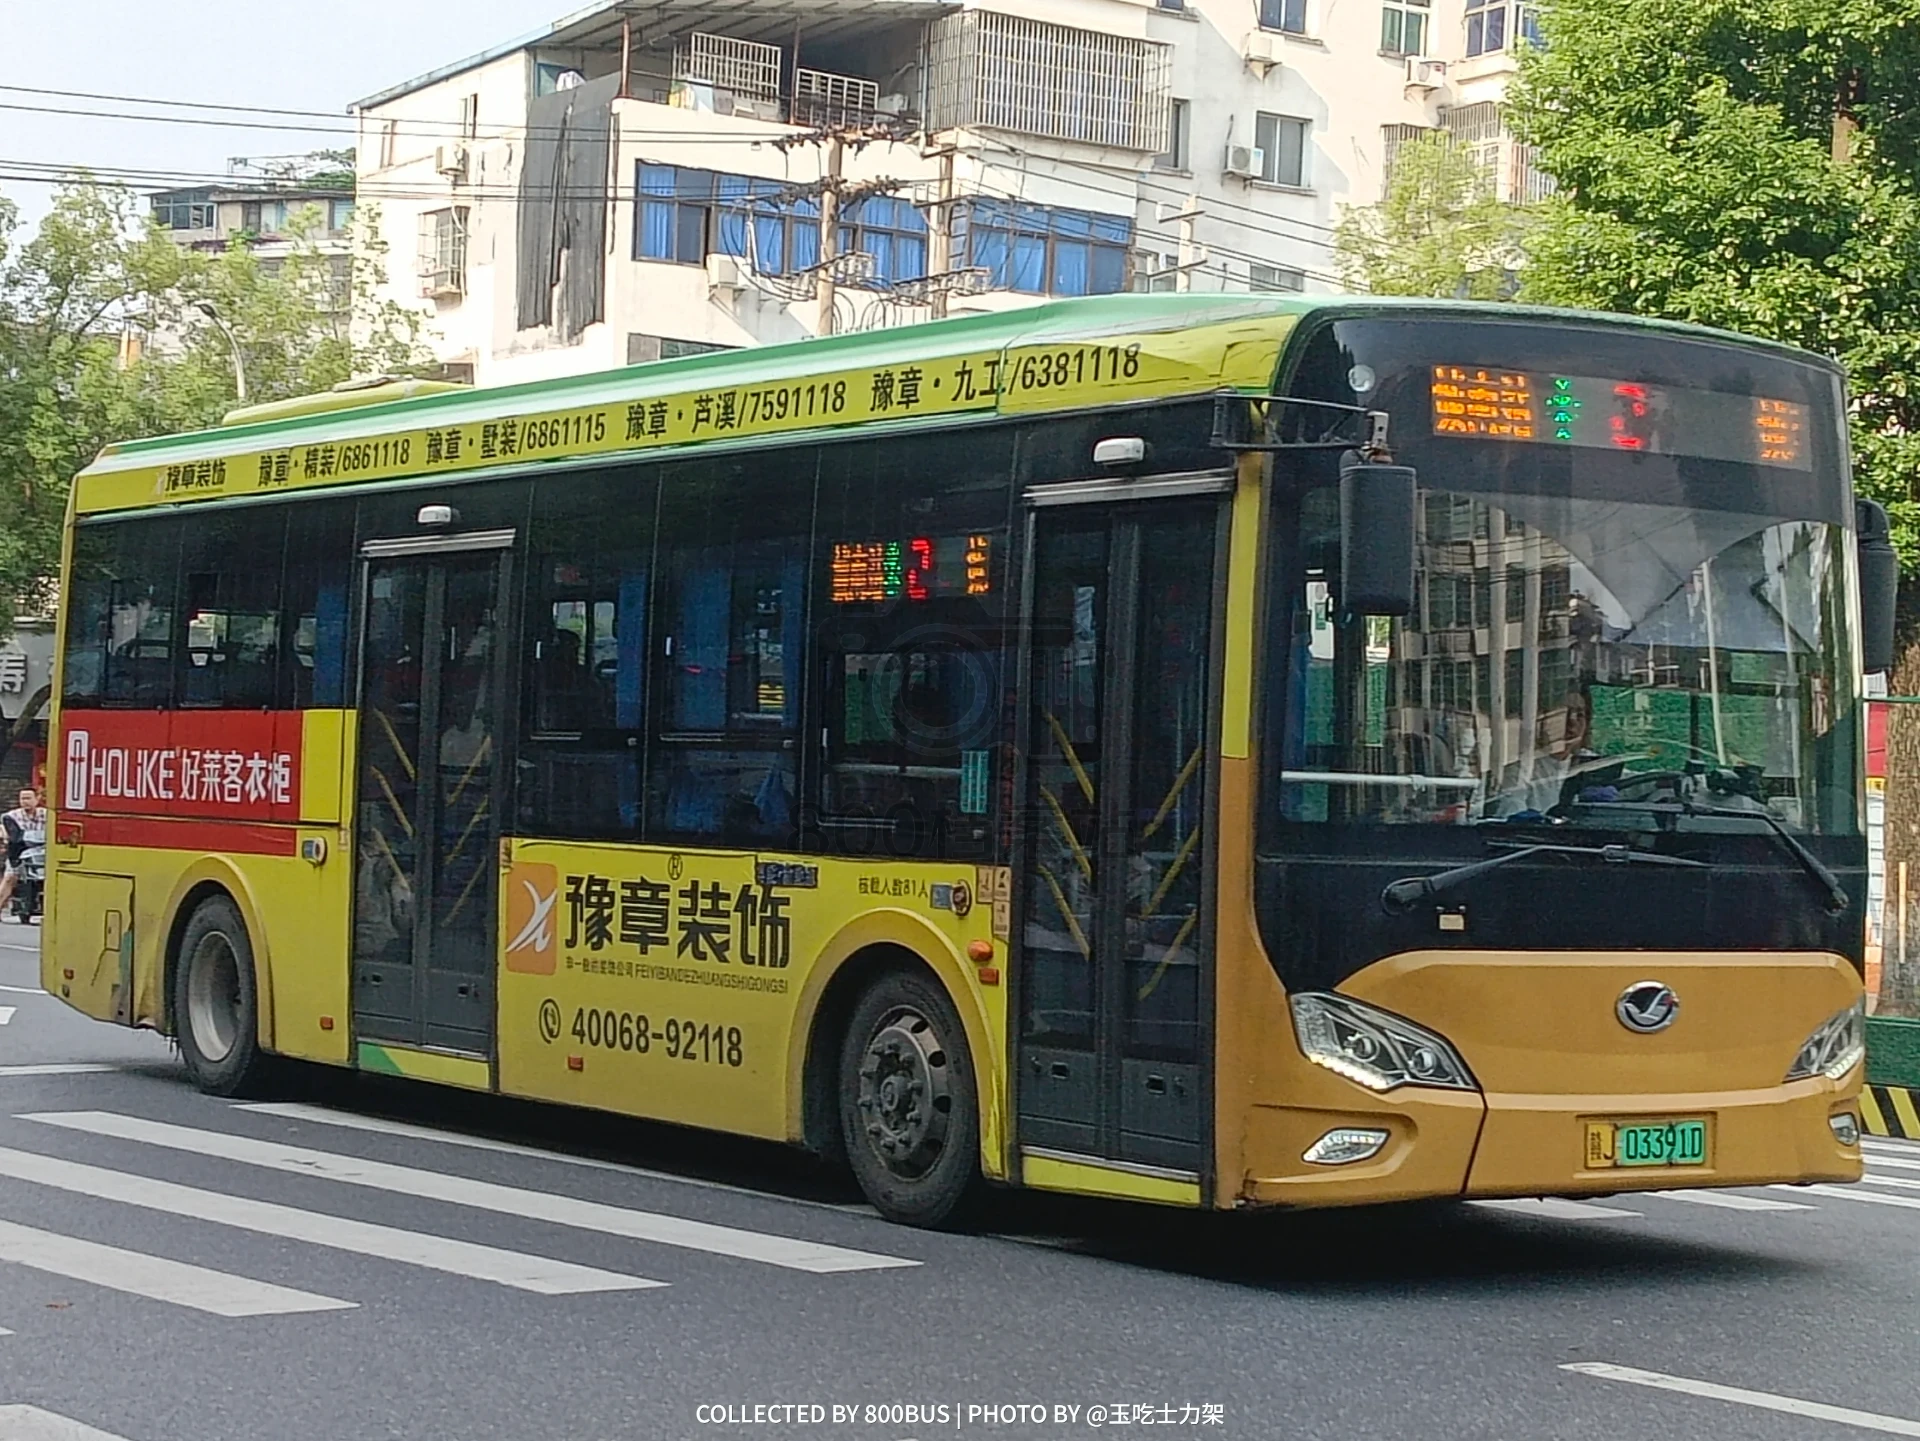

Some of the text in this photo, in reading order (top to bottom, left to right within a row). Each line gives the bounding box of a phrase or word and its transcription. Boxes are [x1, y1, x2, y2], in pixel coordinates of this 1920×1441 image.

[180, 751, 291, 803] 好莱客衣柜
[565, 874, 791, 968] 豫章装饰
[571, 1007, 743, 1067] 40068-92118
